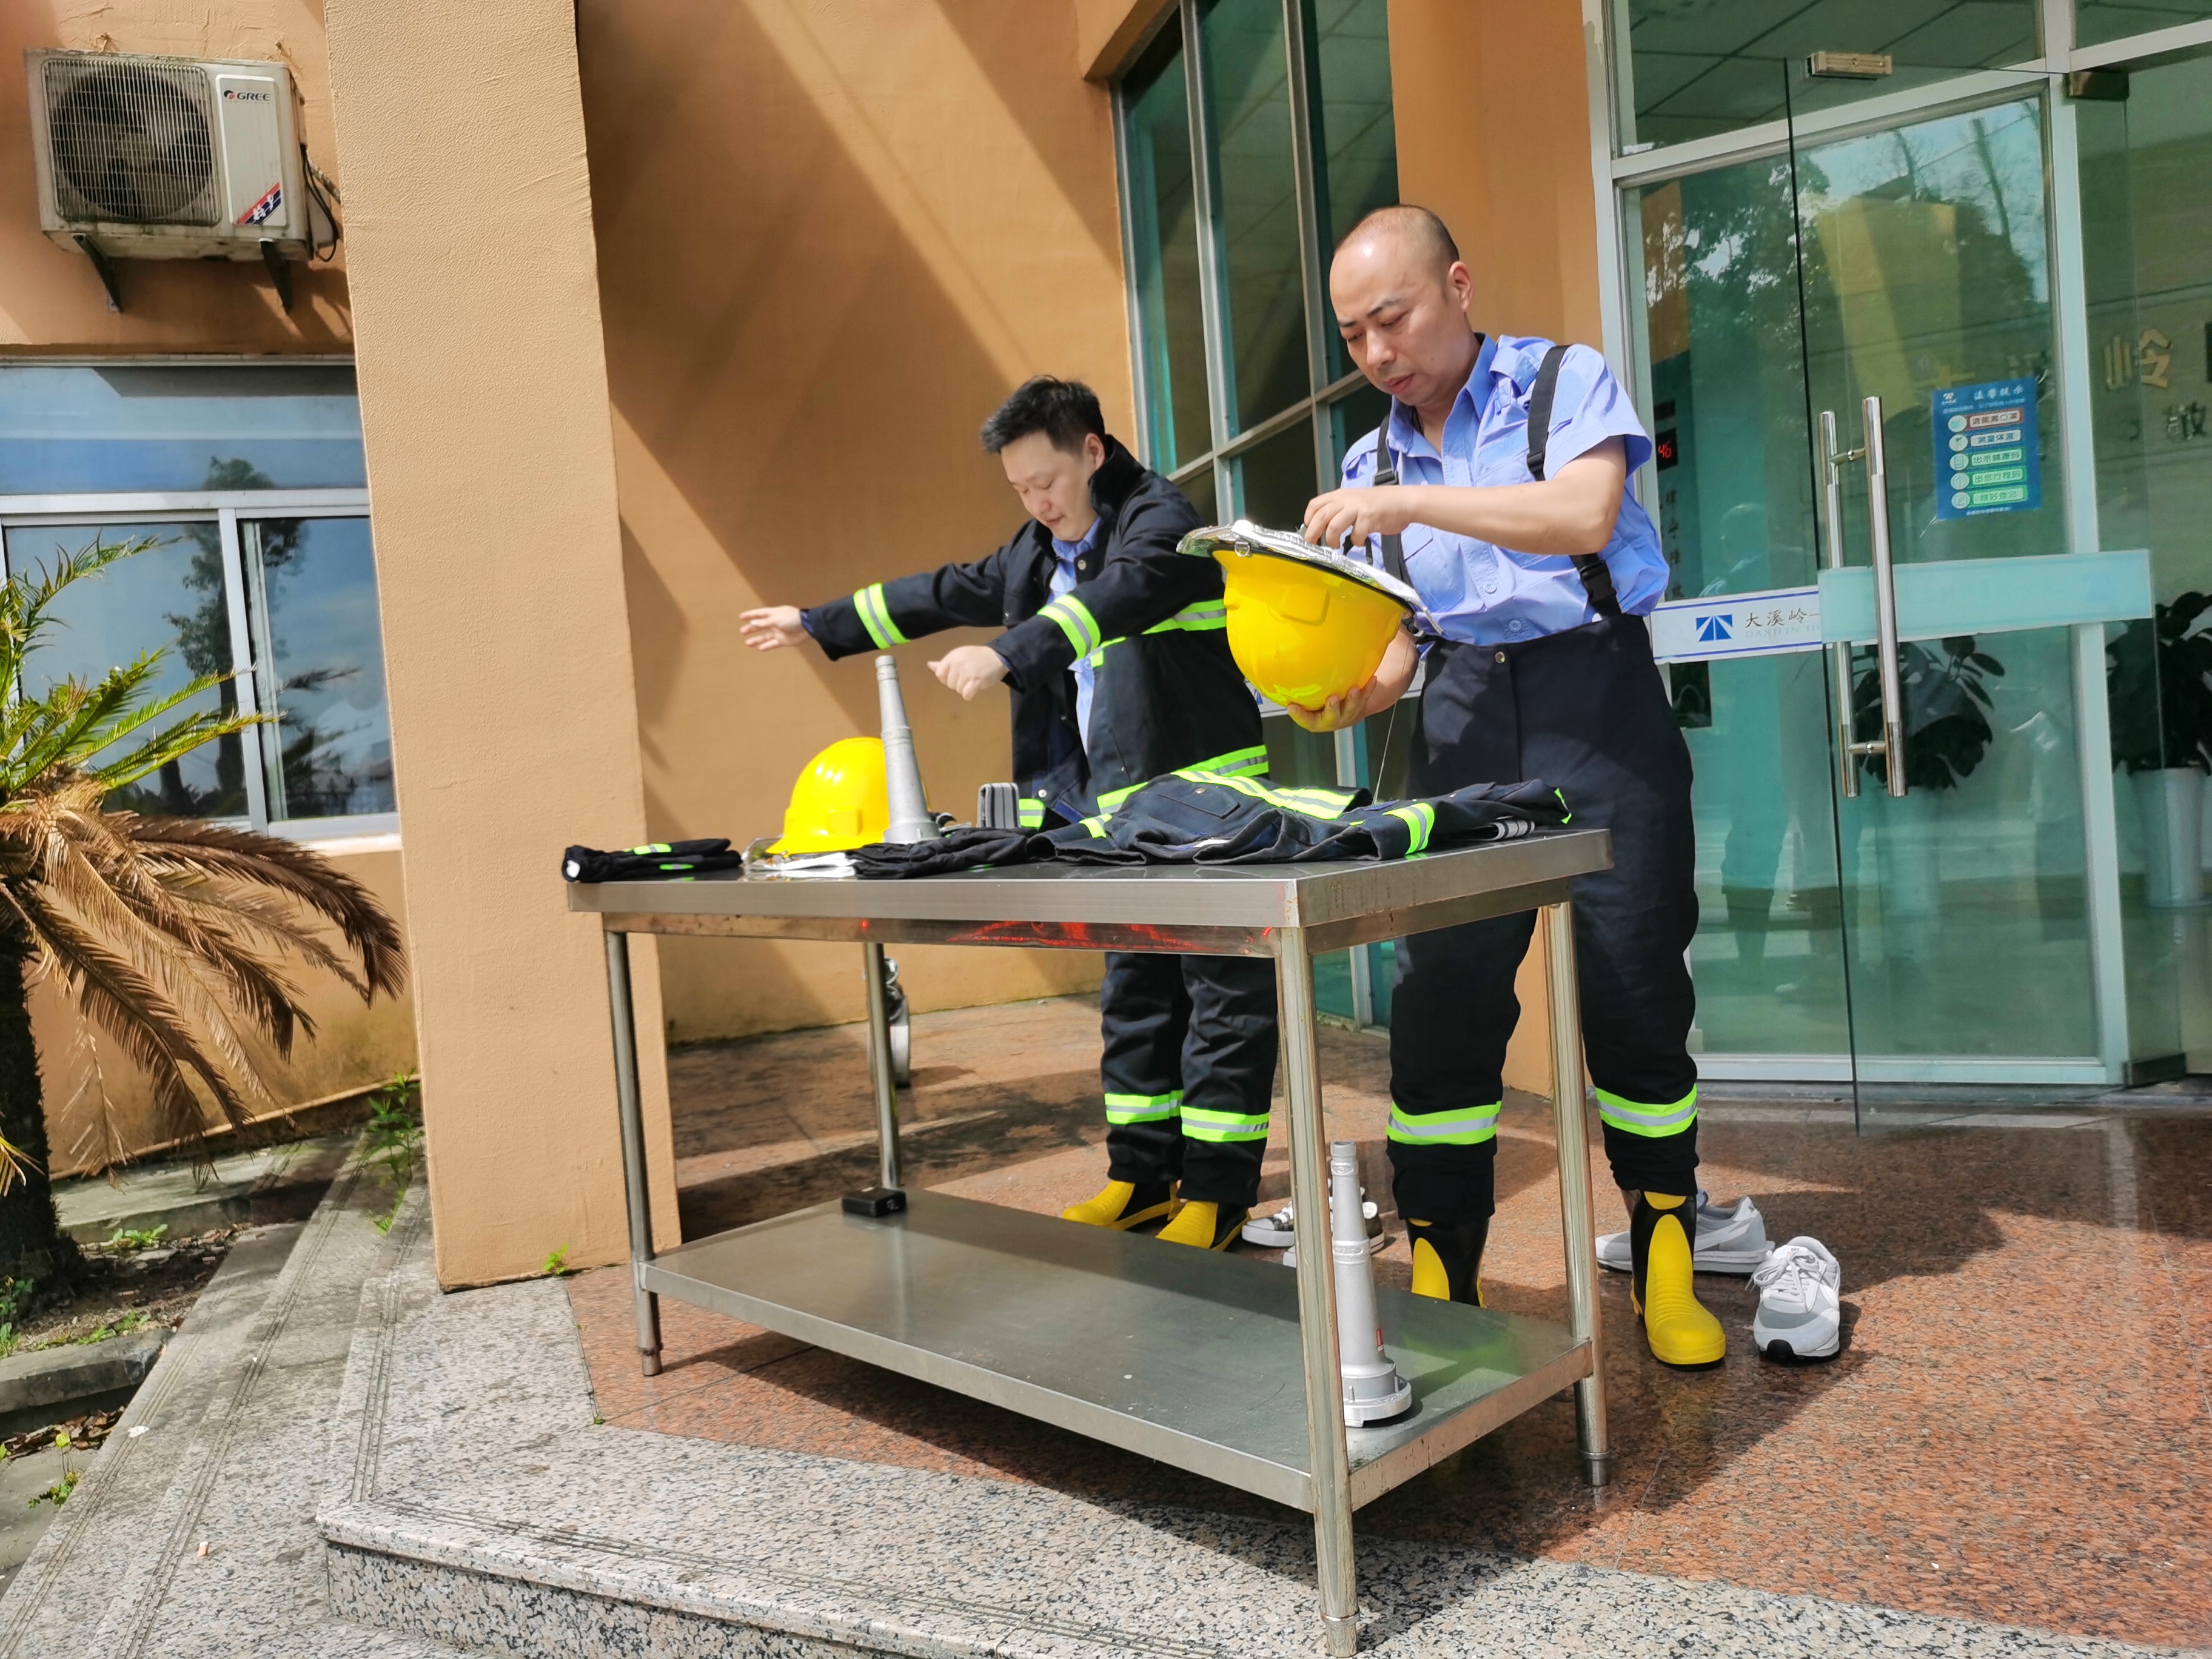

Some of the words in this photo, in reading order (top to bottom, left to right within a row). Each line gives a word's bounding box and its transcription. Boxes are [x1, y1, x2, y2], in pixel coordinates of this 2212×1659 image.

[236, 92, 271, 101] GREE
[1977, 433, 2014, 444] 测量体温
[1973, 451, 2020, 464] 出示健康码
[1974, 471, 2021, 483] 出示行程码
